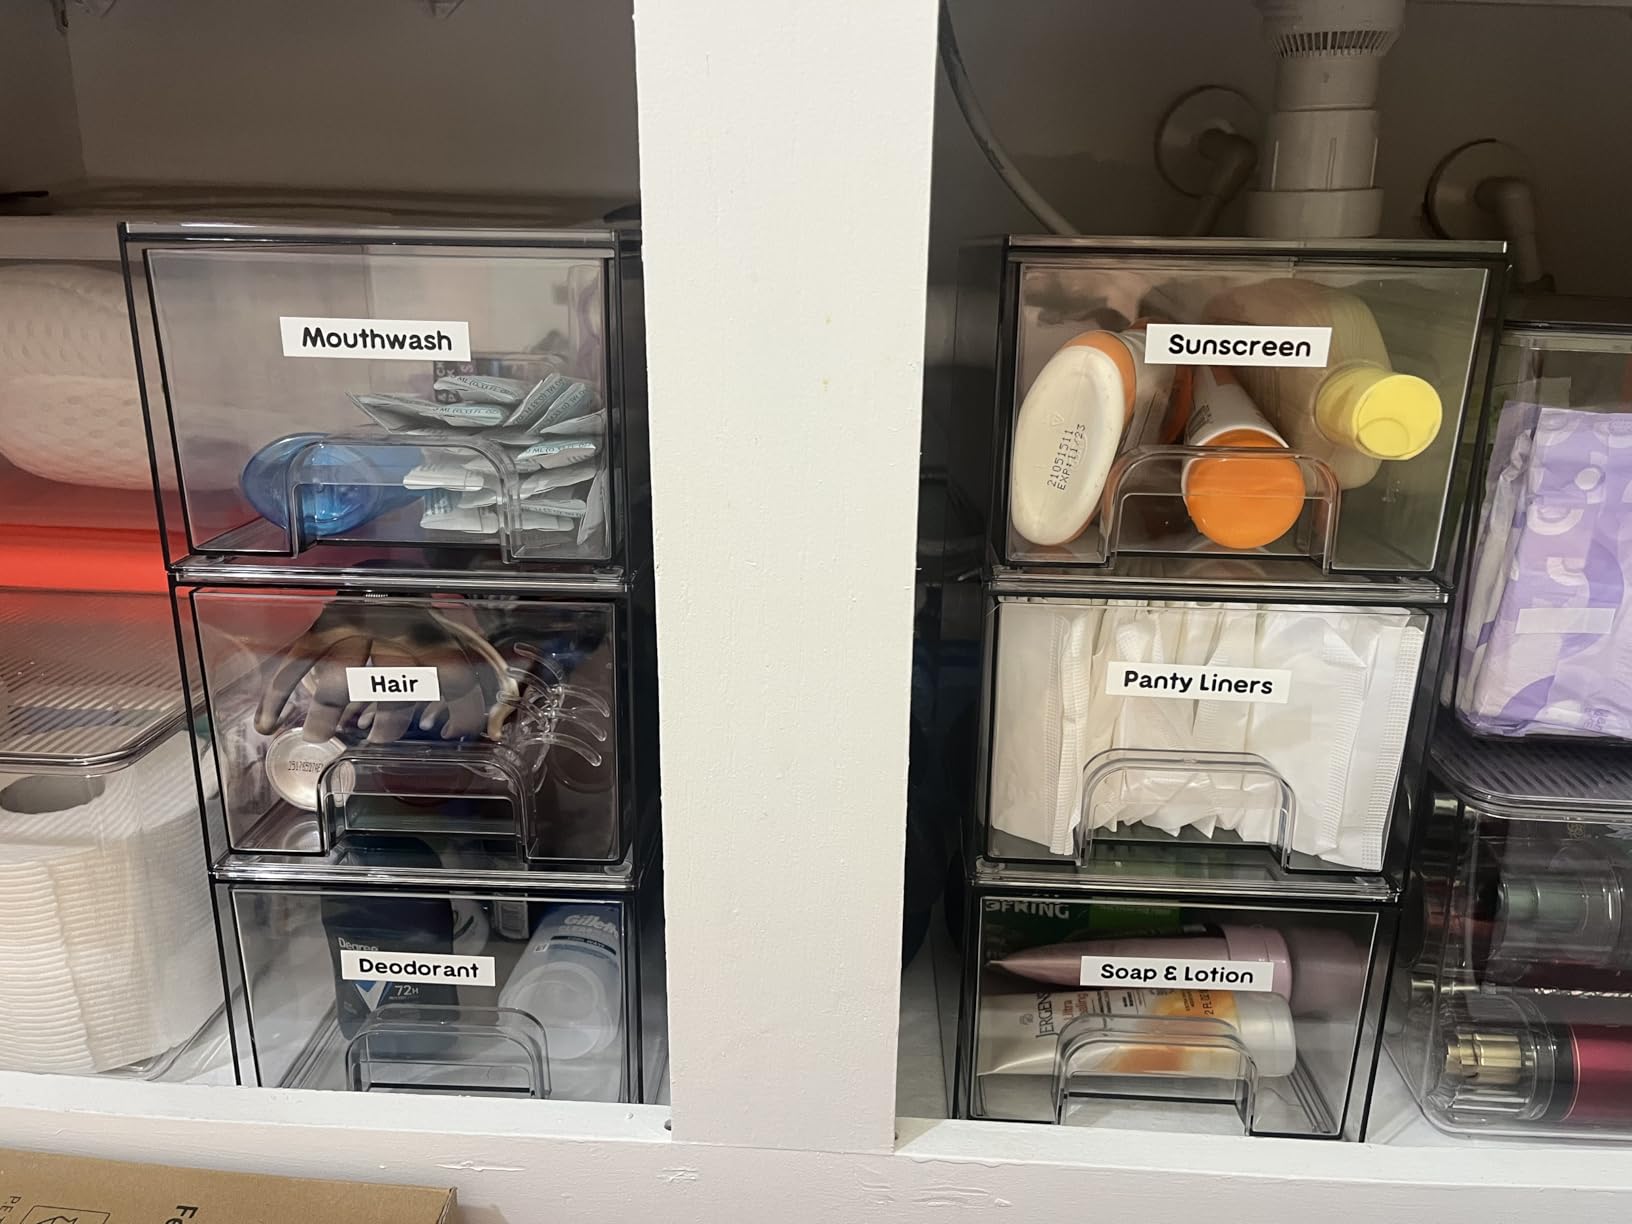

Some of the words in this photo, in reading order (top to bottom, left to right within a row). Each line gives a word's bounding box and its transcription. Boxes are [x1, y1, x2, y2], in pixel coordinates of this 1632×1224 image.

[302, 326, 452, 351] Mouthwash
[1168, 333, 1311, 357] Sunscreen
[1046, 429, 1074, 487] 21051511
[370, 674, 419, 693] Hair
[1124, 670, 1193, 693] Panty
[1199, 673, 1273, 695] Liners
[359, 958, 479, 978] Deodorant
[1100, 963, 1158, 983] Soap
[1163, 965, 1177, 981] &
[1184, 966, 1254, 984] Lotion
